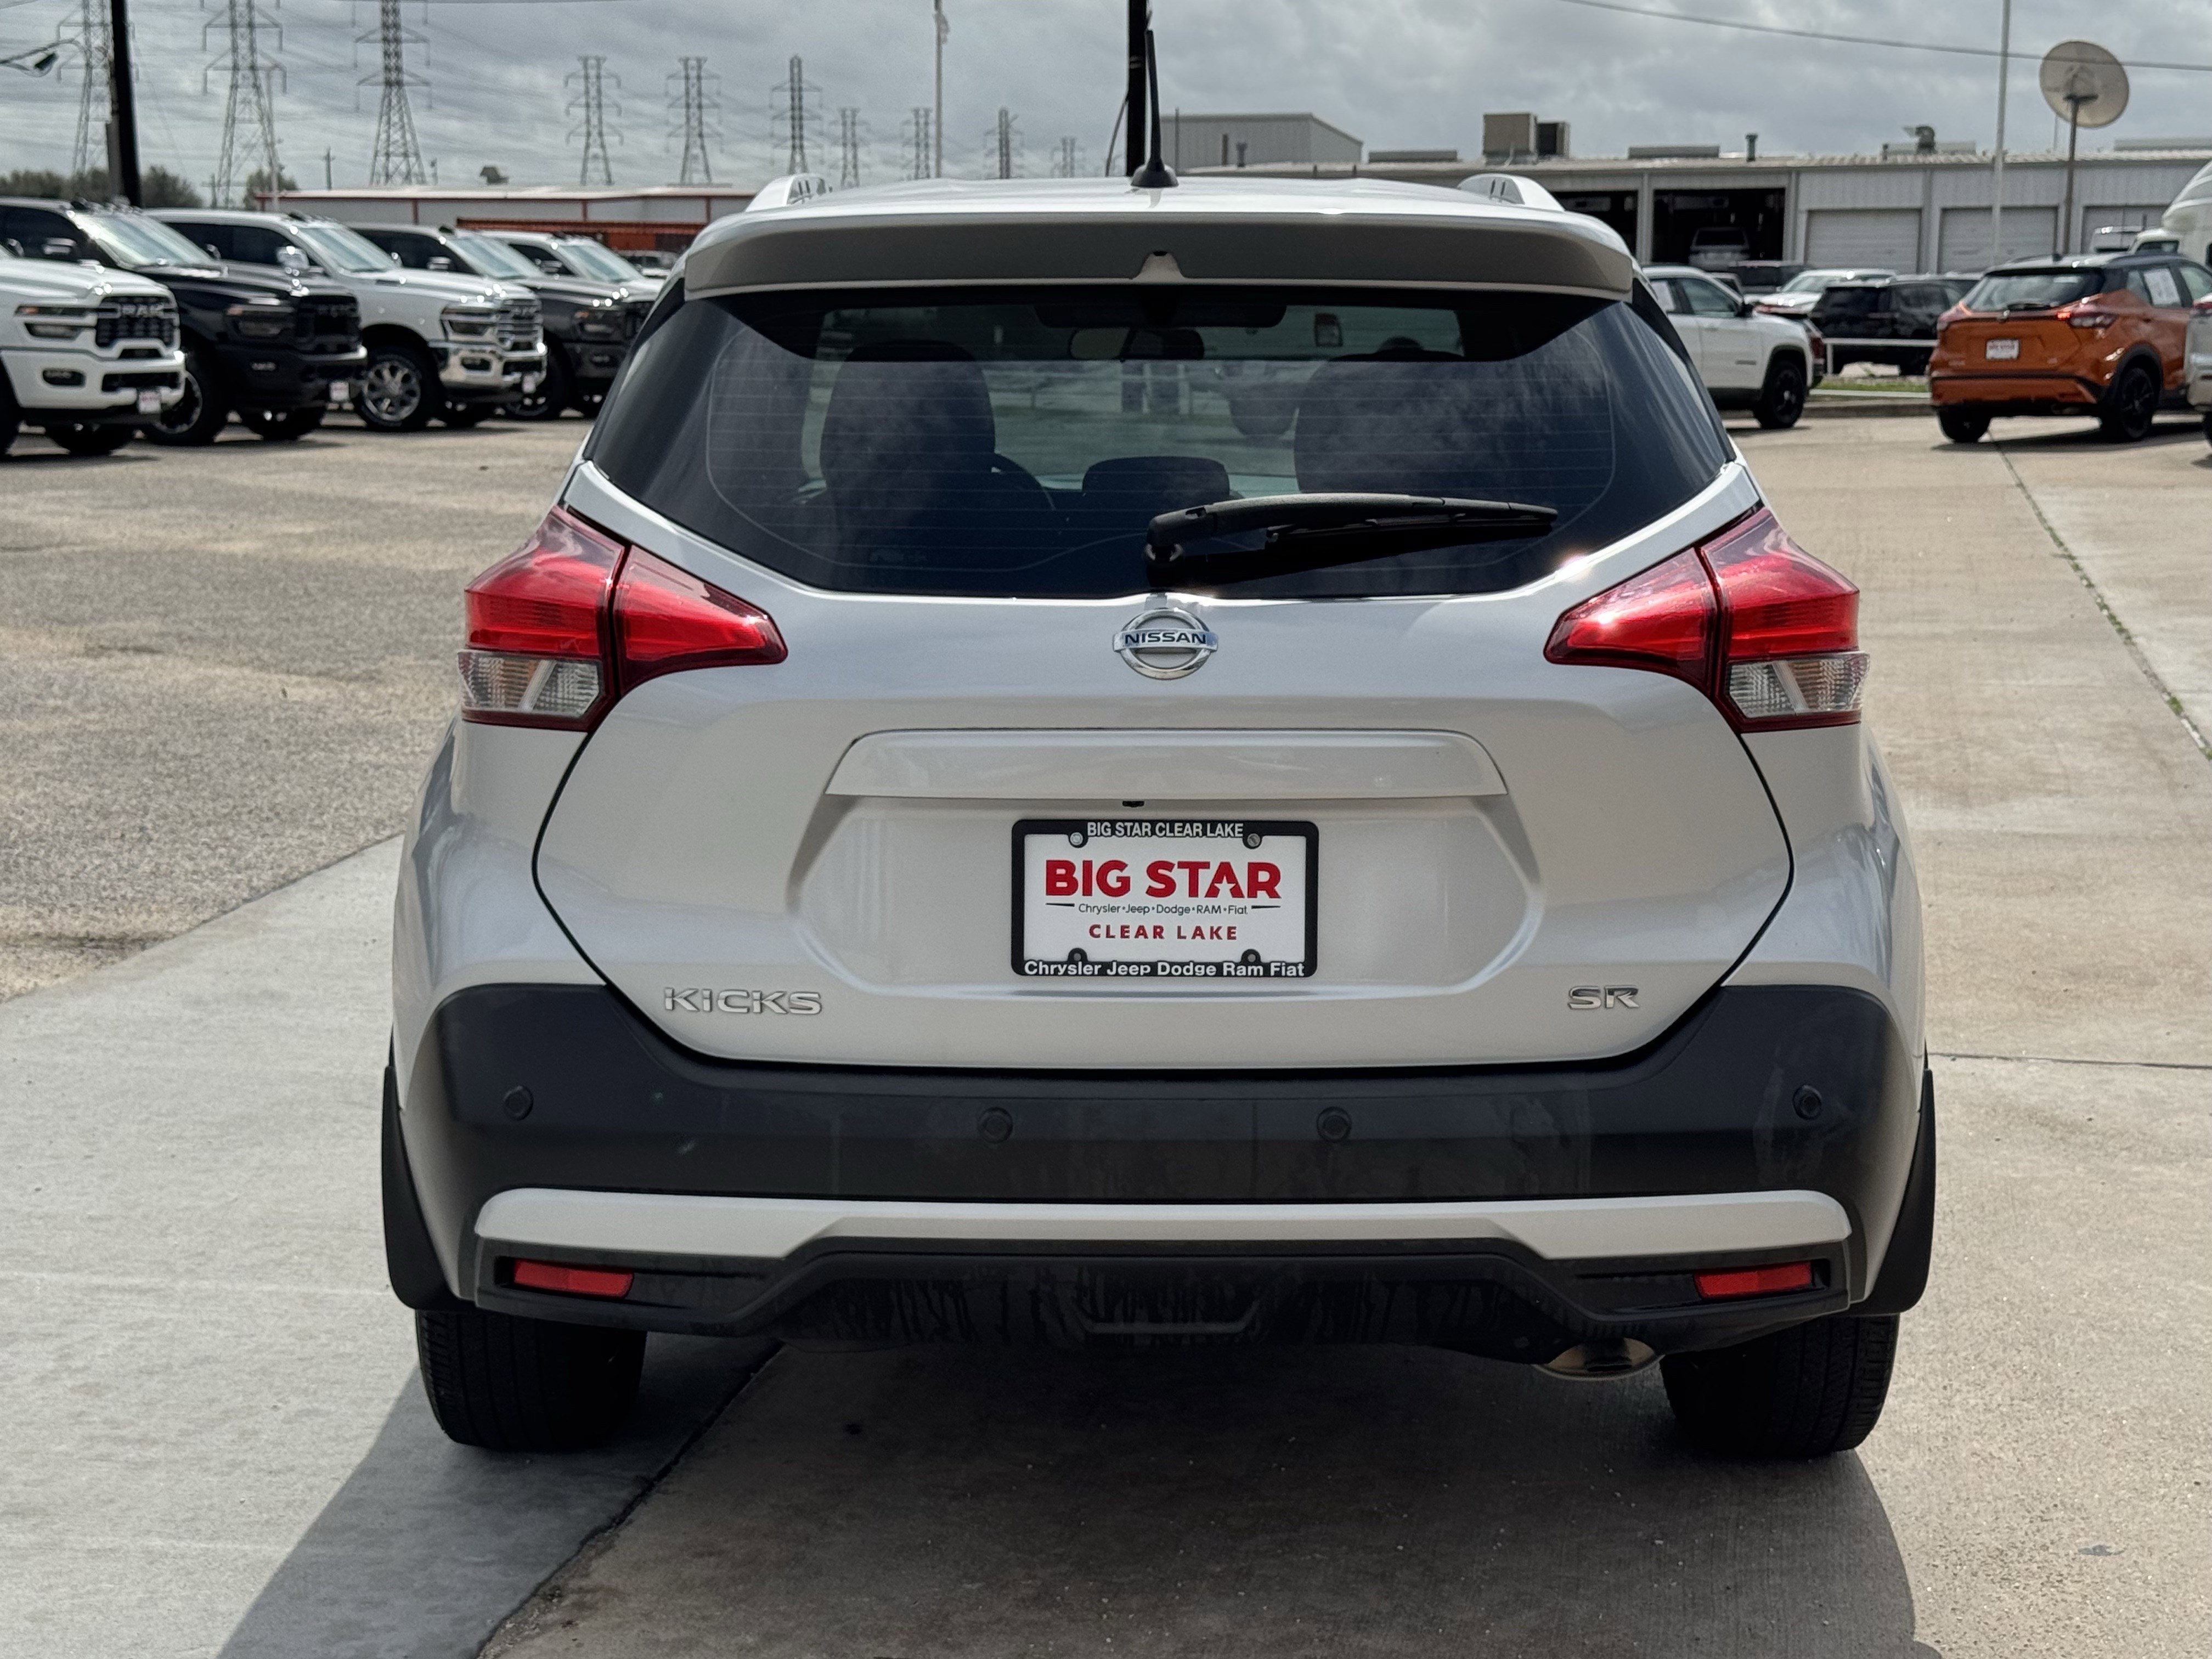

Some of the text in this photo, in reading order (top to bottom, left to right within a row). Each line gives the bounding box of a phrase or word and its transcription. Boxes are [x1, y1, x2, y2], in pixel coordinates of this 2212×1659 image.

[1125, 632, 1206, 644] NISSAN
[1087, 822, 1244, 837] BIG STAR CLEAR LAKE
[1046, 860, 1282, 899] BIG STAR
[1079, 904, 1248, 916] Chrysler Jeep Dodge RAM Fiat
[1089, 924, 1237, 940] CLEAR LAKE
[1024, 961, 1305, 977] Chrysler Jeep Dodge Ram Fiat
[664, 987, 821, 1015] KICKS
[1567, 985, 1639, 1009] SR
